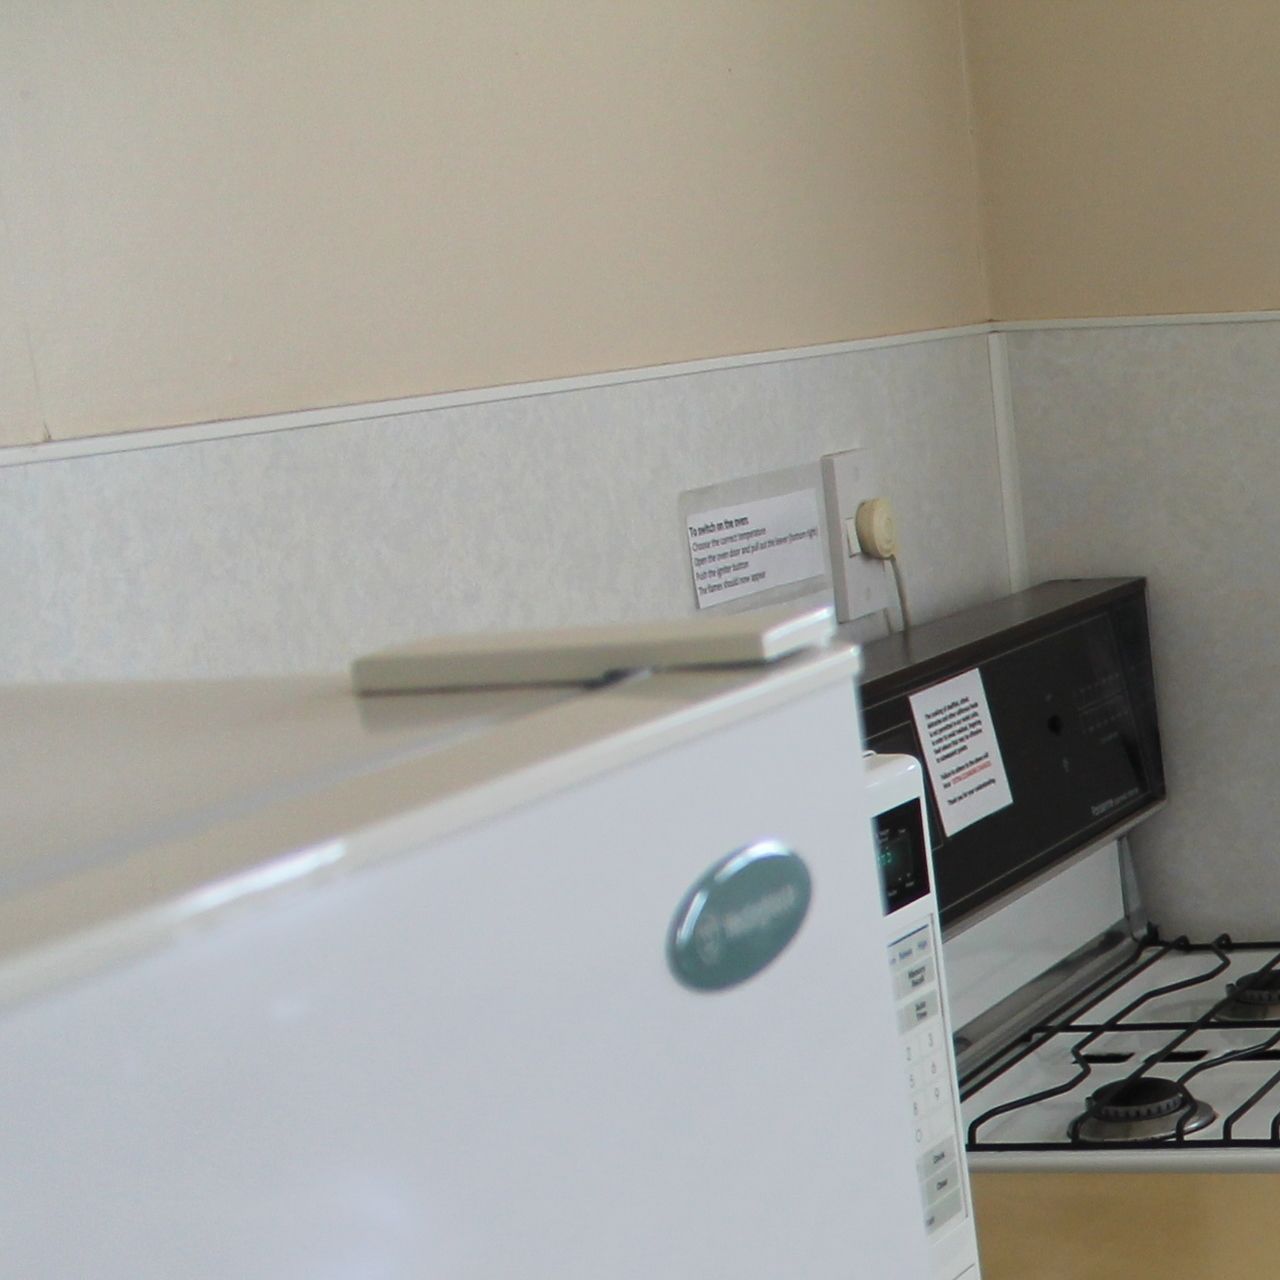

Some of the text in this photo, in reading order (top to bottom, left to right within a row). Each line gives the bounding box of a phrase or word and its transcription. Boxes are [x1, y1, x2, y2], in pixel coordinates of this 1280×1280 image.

[689, 526, 697, 538] To
[699, 522, 716, 536] switch
[717, 522, 723, 531] on
[724, 518, 734, 530] the
[708, 554, 716, 563] the
[717, 551, 729, 561] oven
[730, 548, 741, 558] door
[742, 546, 750, 555] and
[708, 568, 716, 578] the
[724, 577, 738, 589] should
[740, 576, 750, 585] now
